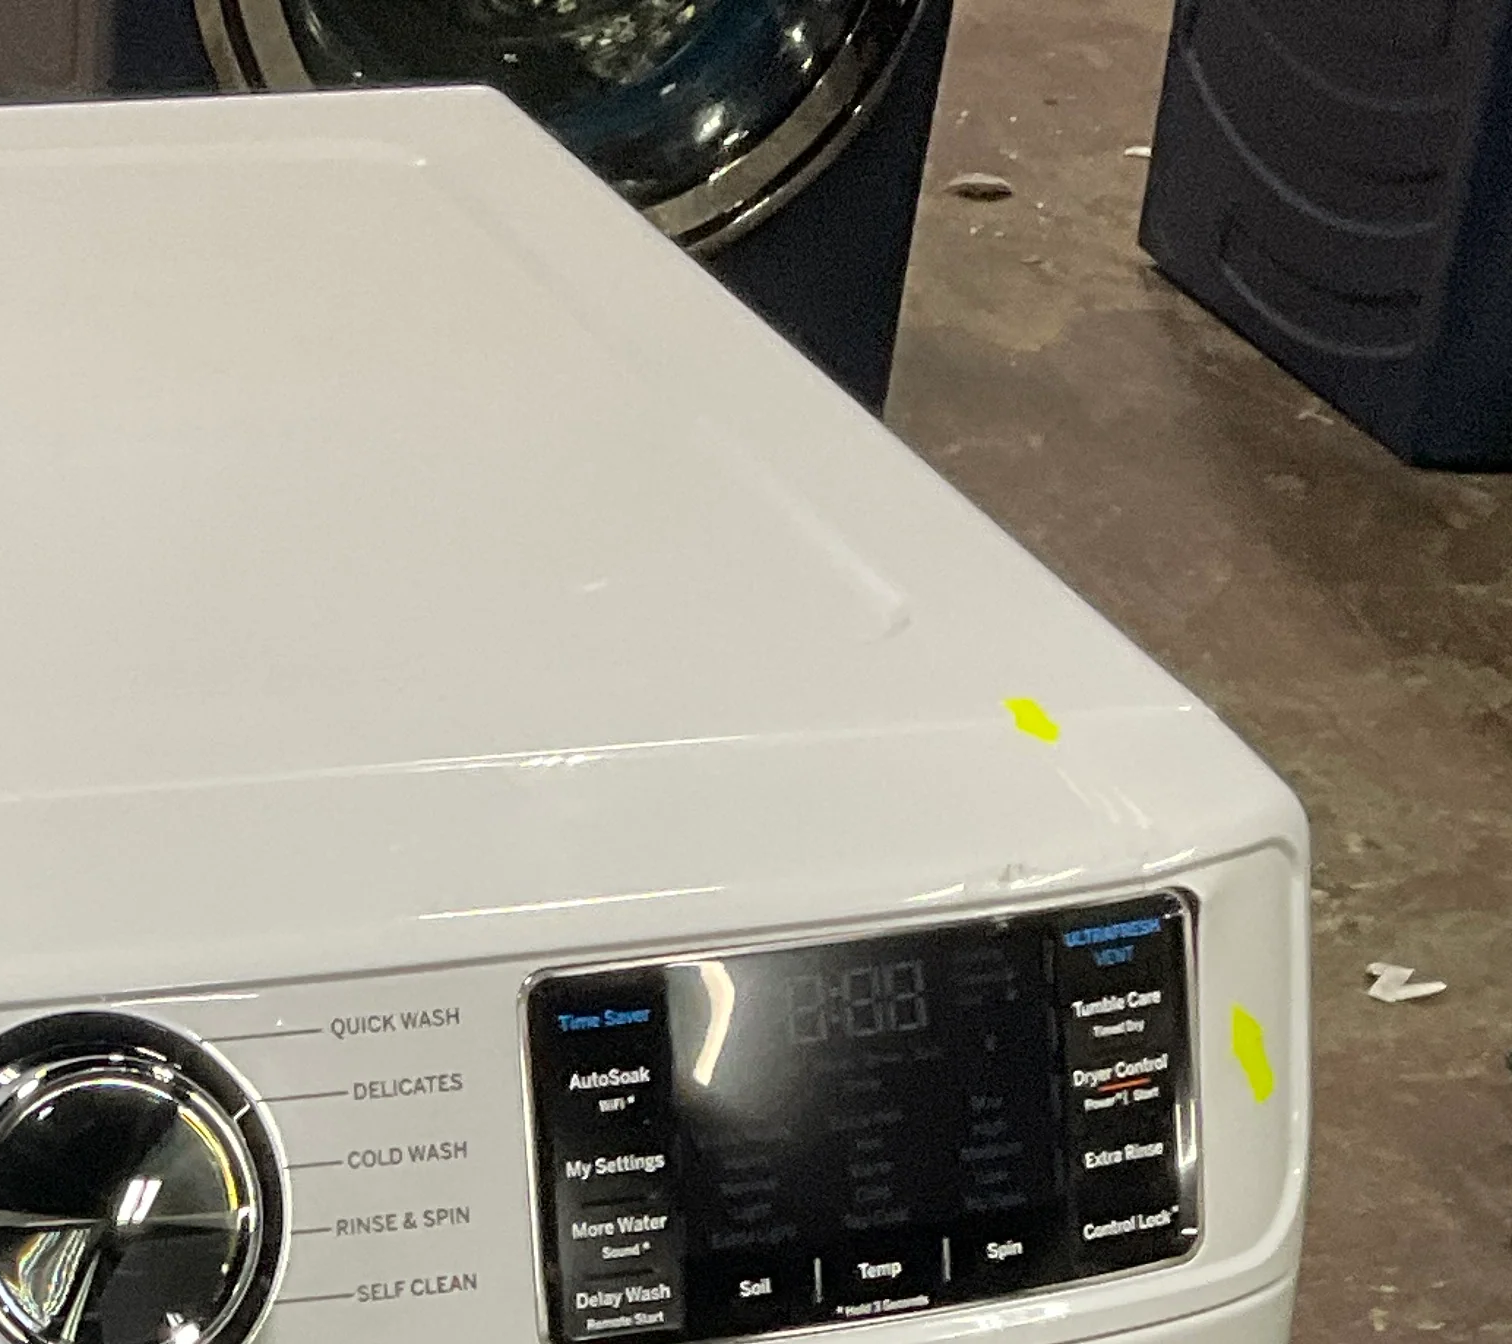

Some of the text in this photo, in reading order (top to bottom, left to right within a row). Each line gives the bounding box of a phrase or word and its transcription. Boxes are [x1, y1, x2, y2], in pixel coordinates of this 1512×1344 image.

[330, 1007, 461, 1039] QUICK WASH
[569, 1065, 651, 1091] AutoSoak
[1114, 1053, 1169, 1078] Control
[353, 1072, 464, 1101] DELICATES
[346, 1141, 468, 1170] COLD WASH
[565, 1153, 666, 1181] My Settings
[1084, 1150, 1123, 1169] Extra
[335, 1206, 471, 1237] RINSE & SPIN
[572, 1215, 668, 1240] More Water
[1082, 1215, 1136, 1241] Control
[986, 1239, 1024, 1260] Spin
[856, 1261, 903, 1280] Temp
[355, 1273, 478, 1303] SELF CLEAN
[575, 1283, 672, 1310] Delay Wash
[739, 1276, 773, 1297] Soil
